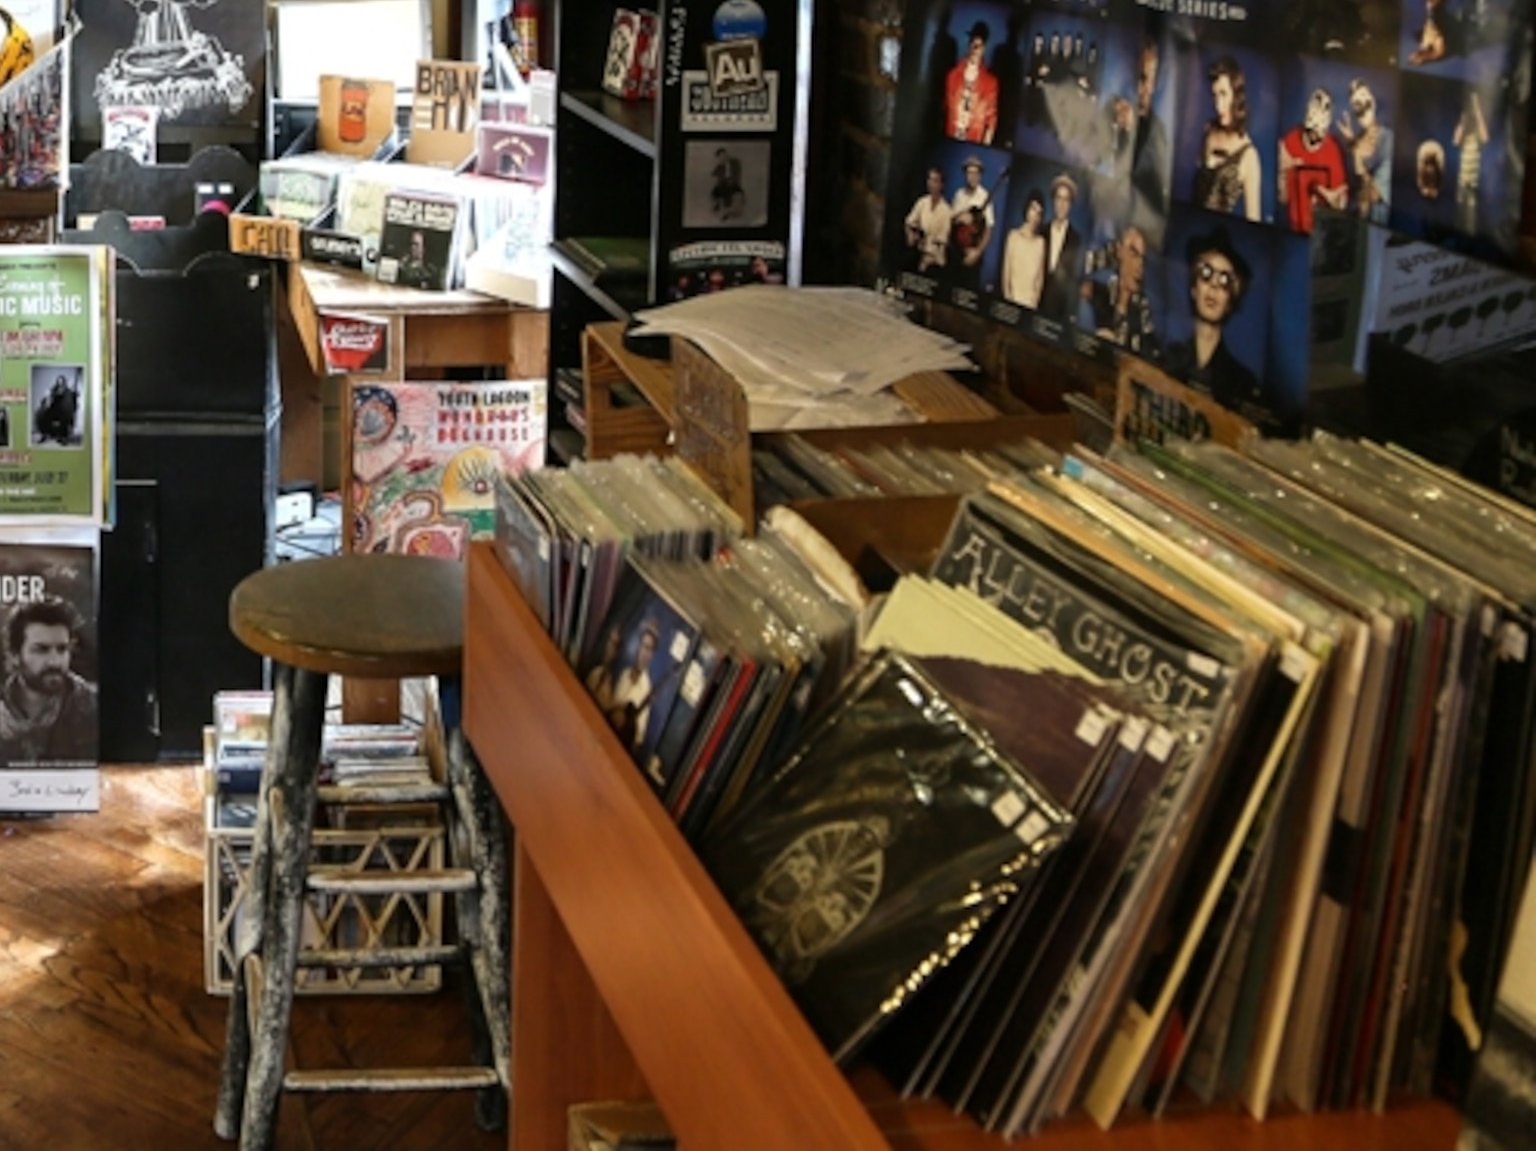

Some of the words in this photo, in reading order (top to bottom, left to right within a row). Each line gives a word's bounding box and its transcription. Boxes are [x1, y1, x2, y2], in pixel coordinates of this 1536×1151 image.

[417, 65, 478, 96] BRIAN
[716, 52, 756, 86] Au
[21, 294, 82, 316] MUSIC
[954, 533, 1068, 629] ALLEY
[1071, 612, 1212, 712] GHOST
